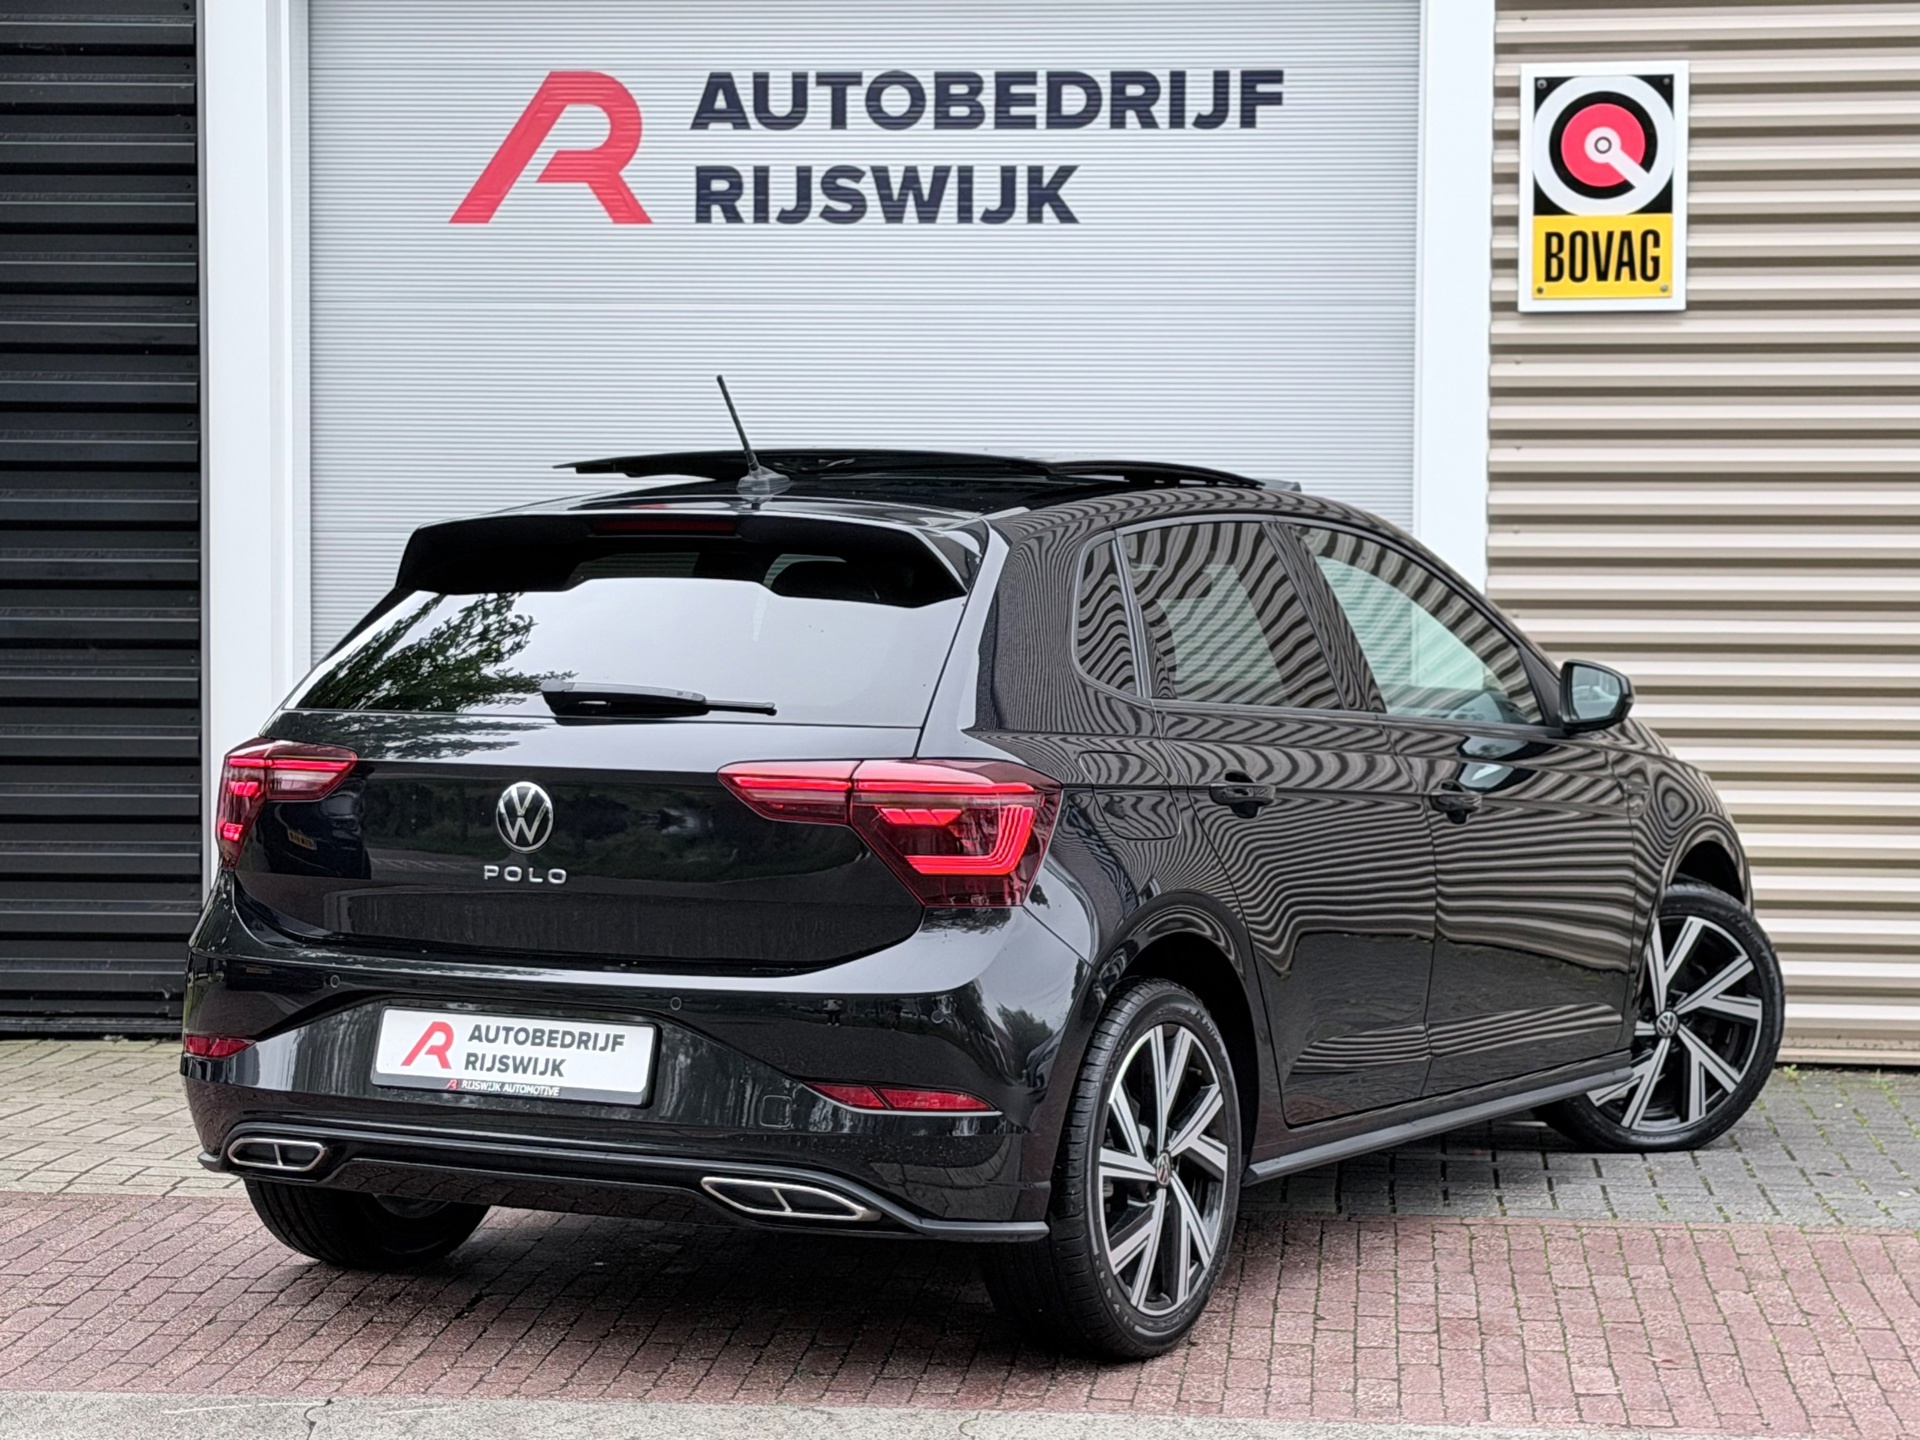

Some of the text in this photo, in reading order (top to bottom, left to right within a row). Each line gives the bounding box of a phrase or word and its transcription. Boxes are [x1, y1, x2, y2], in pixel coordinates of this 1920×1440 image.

[690, 69, 1284, 131] AUTOBEDRIJF
[695, 165, 1080, 225] RIJSWIJK
[1544, 229, 1661, 283] BOVAG
[484, 865, 567, 884] POLO
[467, 1024, 625, 1052] AUTOBEDRIJF
[464, 1052, 567, 1078] RIJSWIJK
[461, 1079, 560, 1097] RIJSWIJK AUTOMOTIVE
